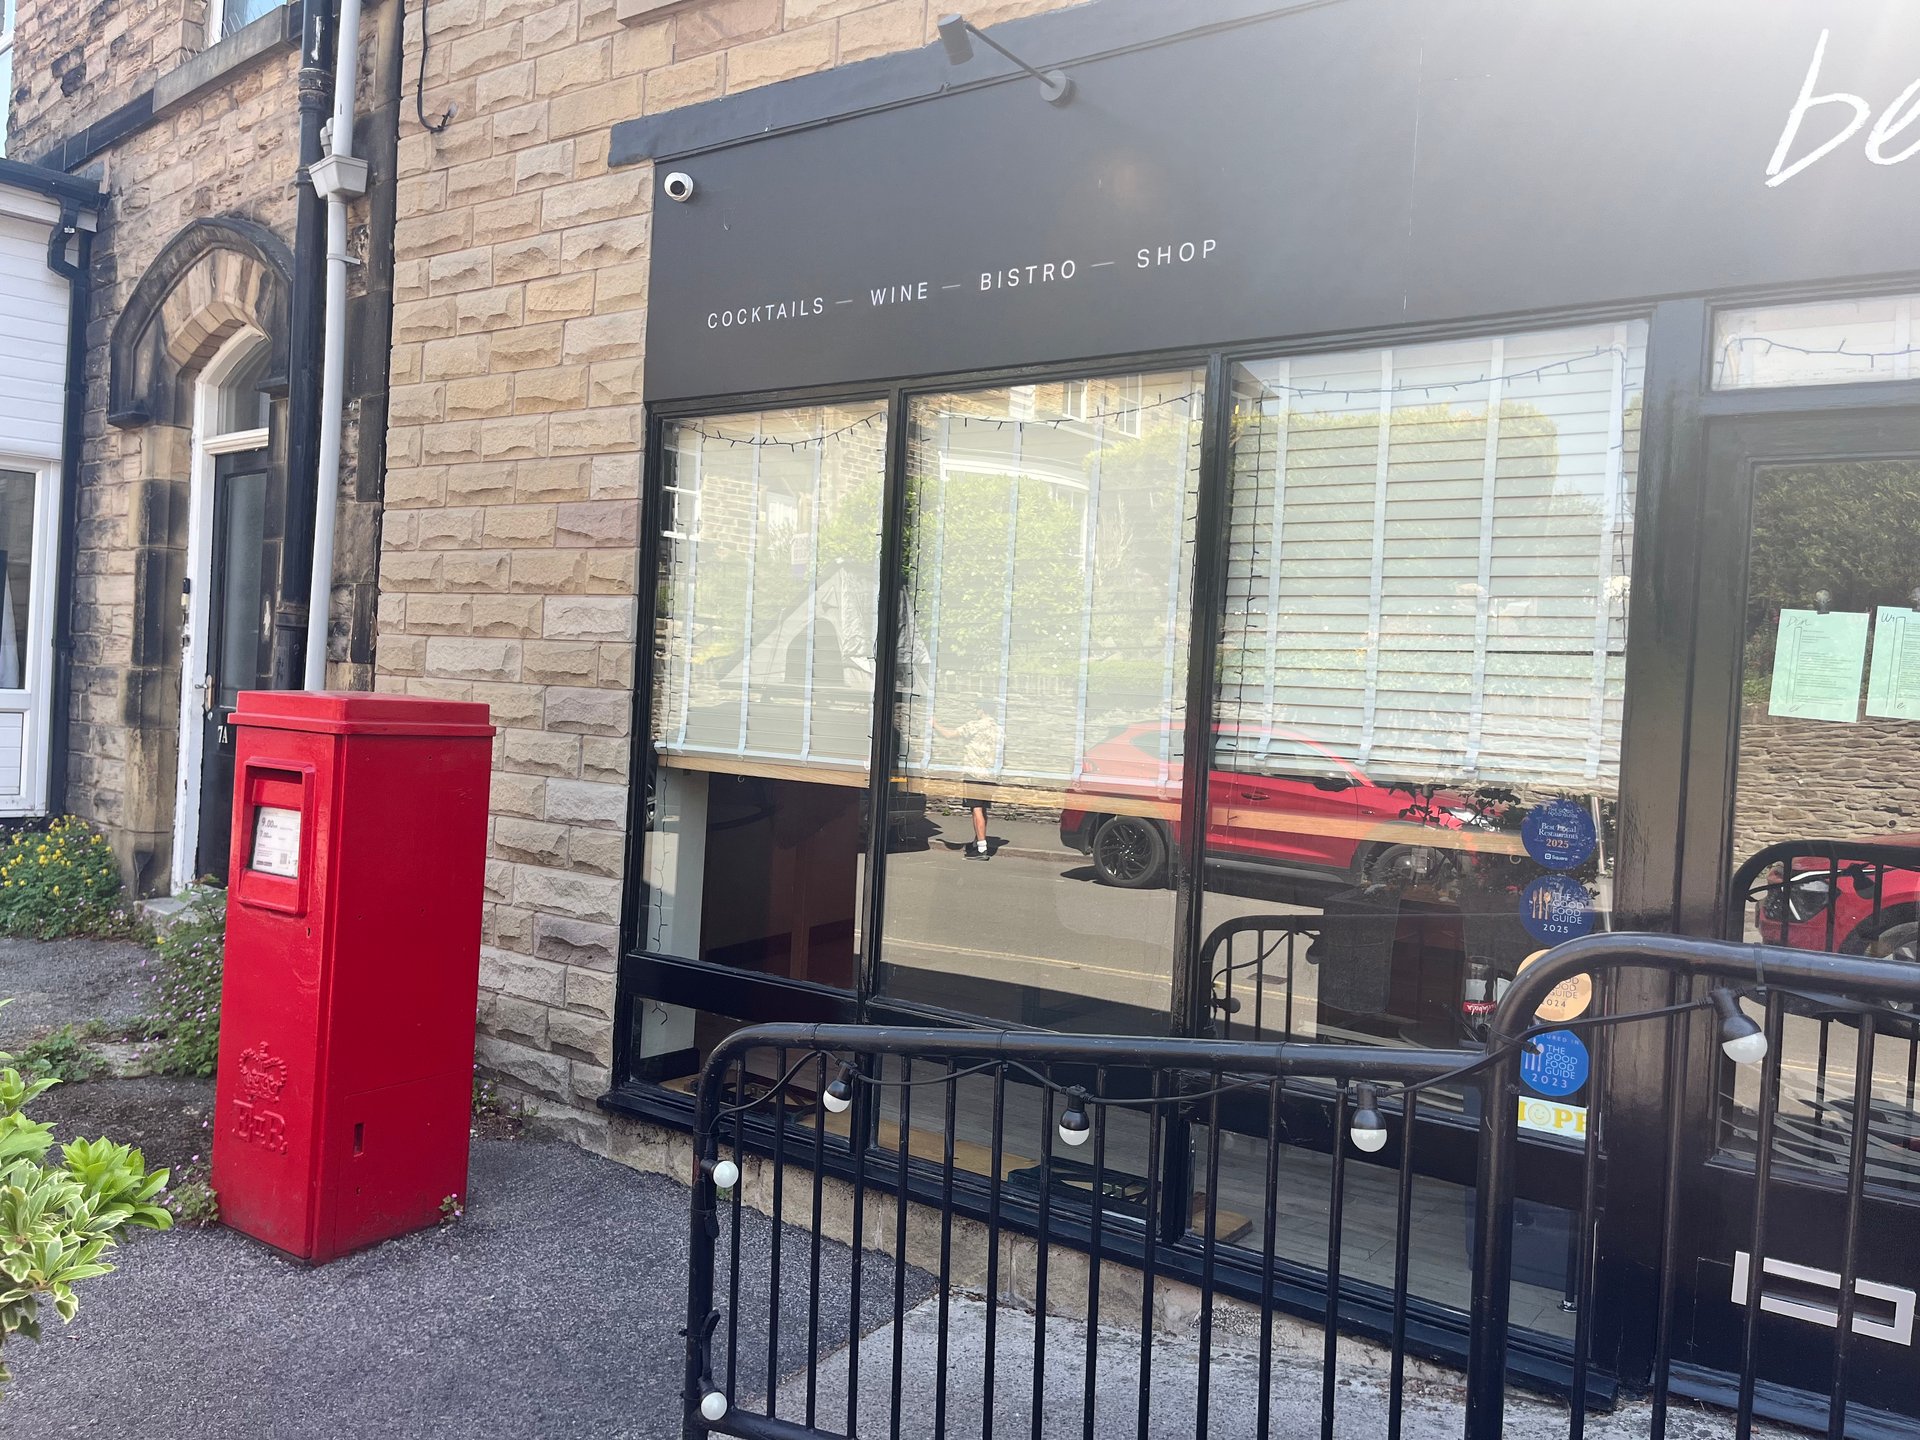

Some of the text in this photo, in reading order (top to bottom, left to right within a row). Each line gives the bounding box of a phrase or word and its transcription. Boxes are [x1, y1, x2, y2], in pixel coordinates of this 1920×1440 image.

[1764, 27, 1920, 188] be
[707, 239, 1216, 329] COCKTAILS WINE BISTRO SHOP
[217, 725, 228, 744] 7A
[1541, 822, 1577, 833] Best Local
[1538, 828, 1579, 840] Restaurants
[1546, 838, 1569, 849] 2025
[1552, 892, 1572, 901] THE
[1552, 900, 1585, 910] GOOD
[1552, 907, 1581, 917] FOOD
[1551, 914, 1582, 925] GUIDE
[1543, 923, 1569, 934] 2025
[1555, 983, 1577, 992] OOD
[1542, 999, 1566, 1008] 024
[1547, 1044, 1566, 1056] THE
[1545, 1052, 1578, 1065] GOOD
[1545, 1059, 1575, 1072] FOOD
[1544, 1066, 1576, 1080] GUIDE
[1531, 1073, 1568, 1089] 2023
